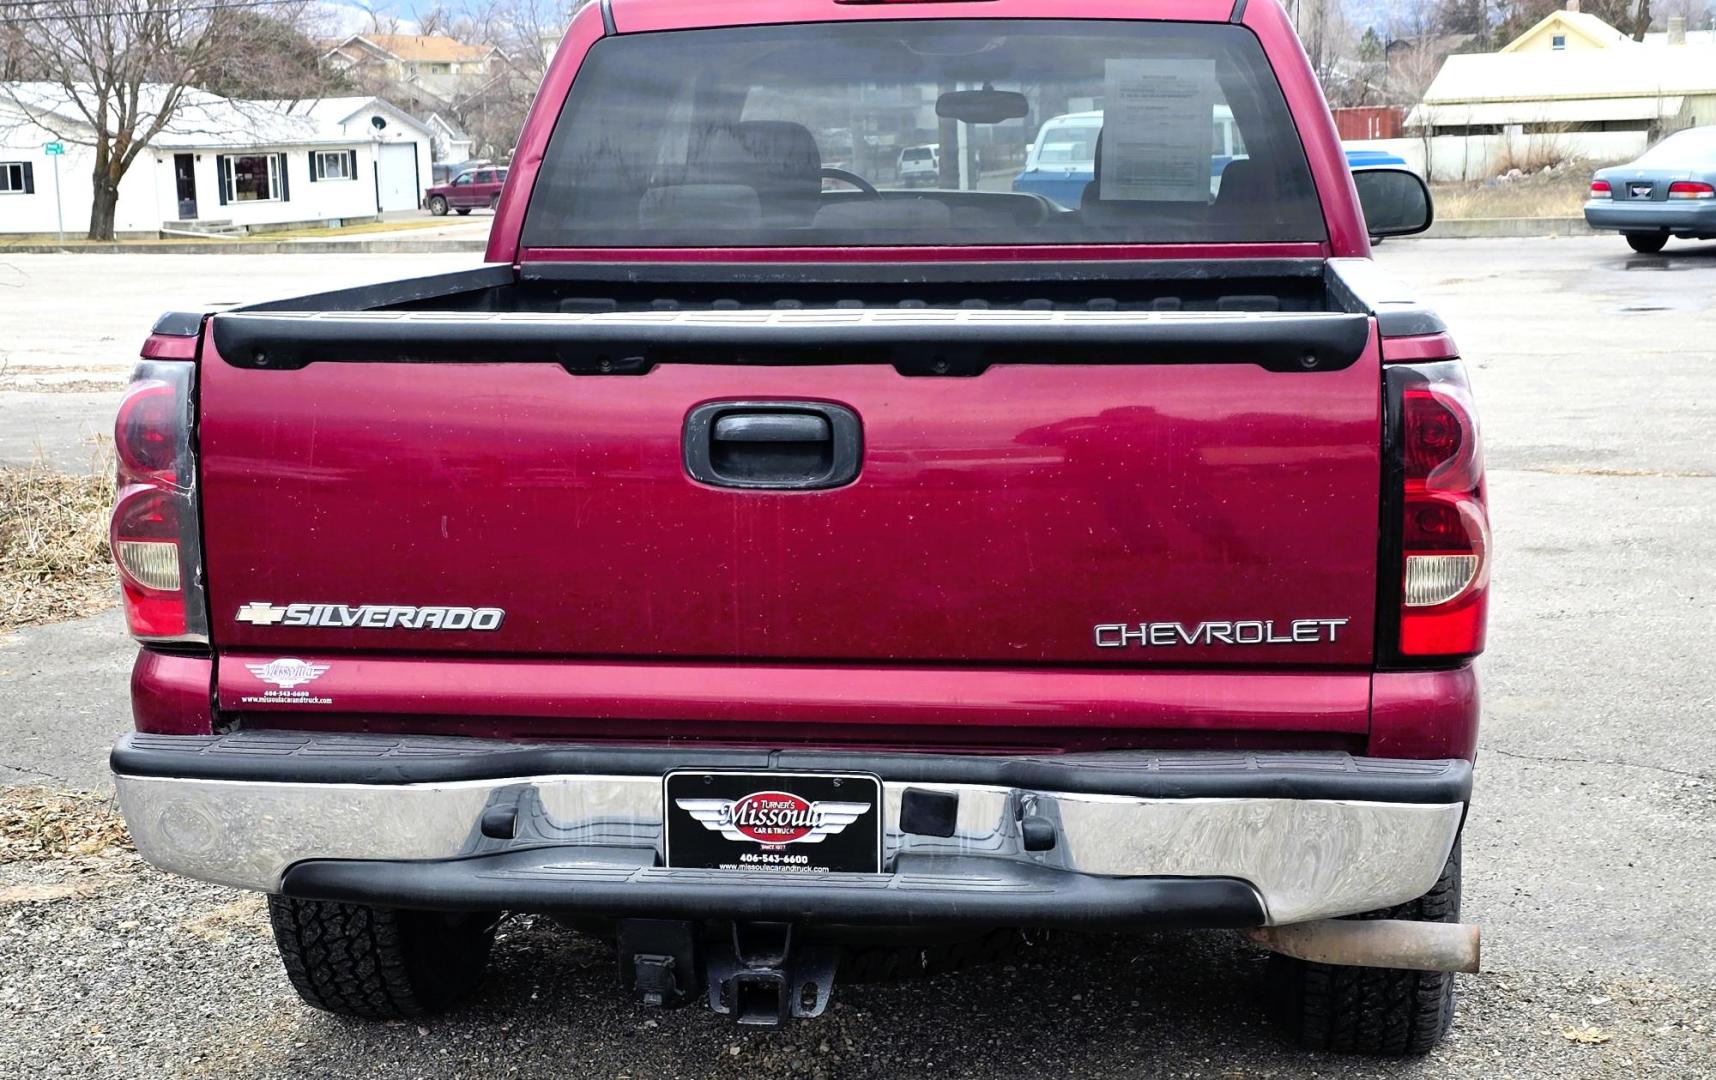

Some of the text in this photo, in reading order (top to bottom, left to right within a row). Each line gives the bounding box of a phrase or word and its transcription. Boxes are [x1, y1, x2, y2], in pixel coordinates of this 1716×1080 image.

[282, 604, 505, 630] SILVERADO
[1094, 618, 1349, 647] CHEVROLET
[719, 799, 825, 827] Missoula
[761, 800, 796, 810] TURNER'S
[774, 827, 795, 835] TRUCK
[740, 853, 808, 864] 406-543-6600
